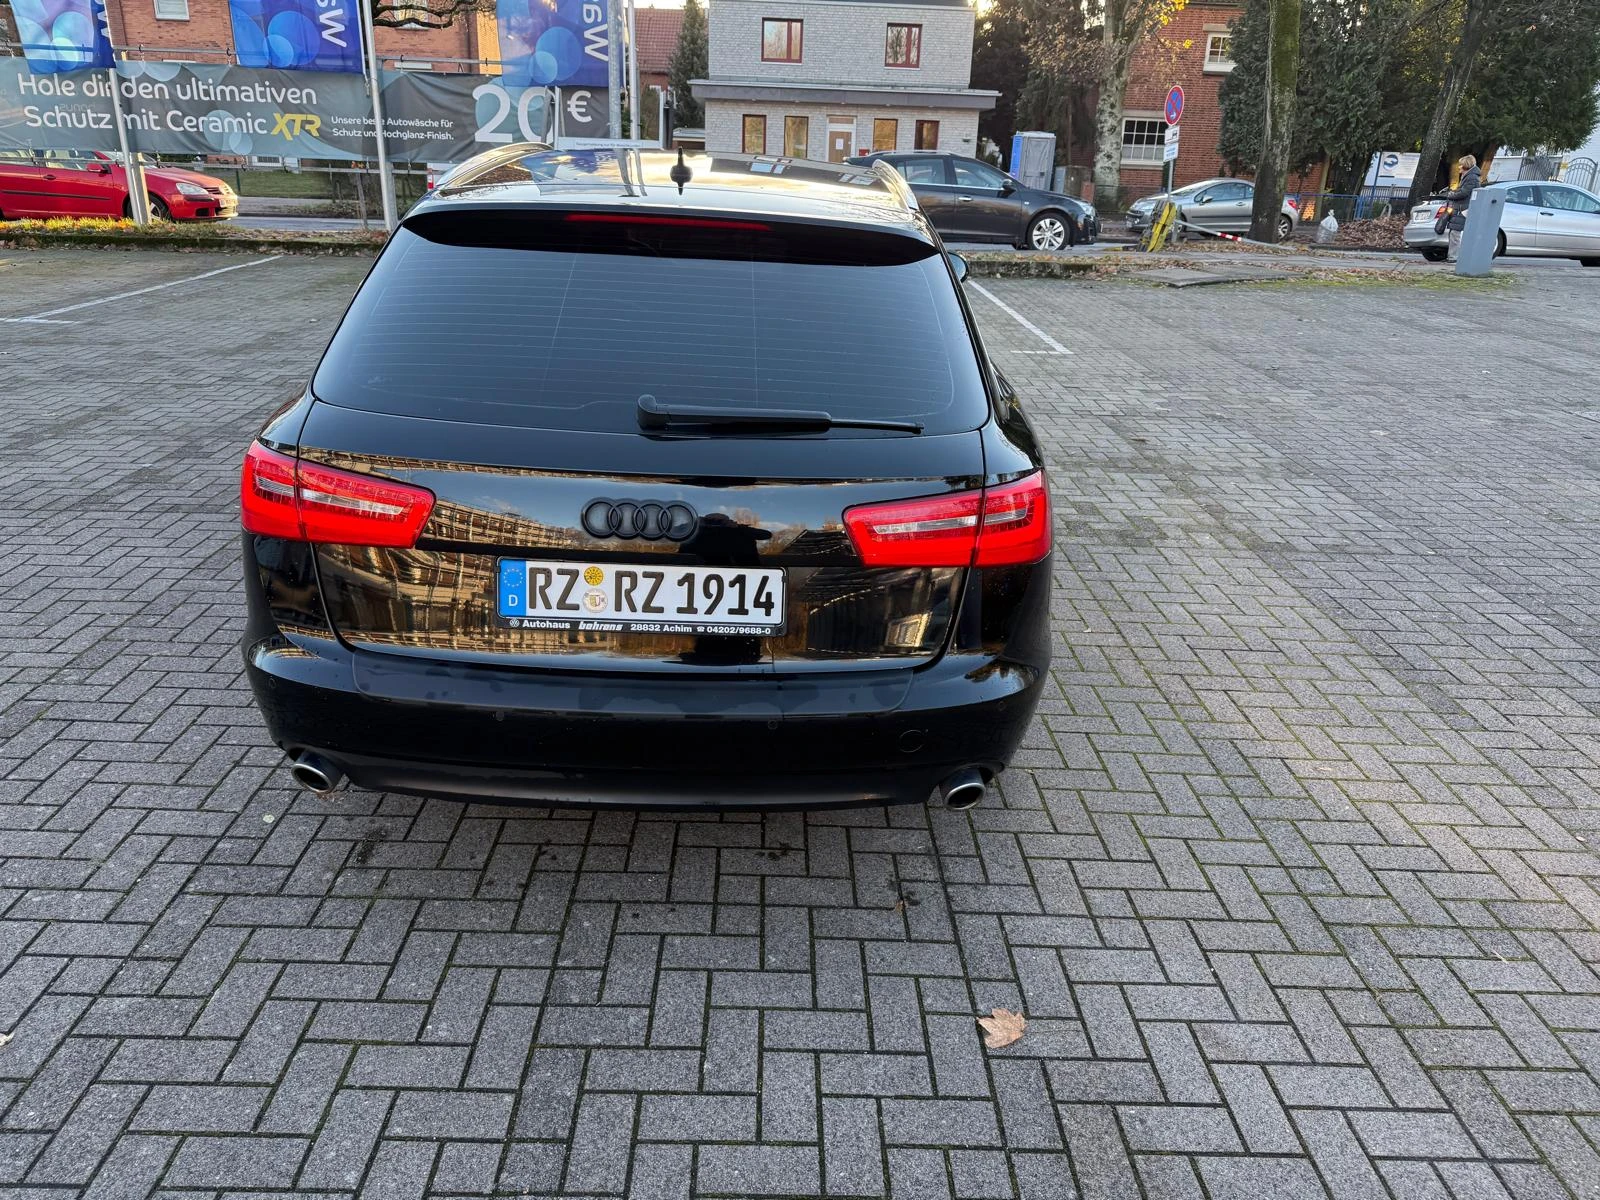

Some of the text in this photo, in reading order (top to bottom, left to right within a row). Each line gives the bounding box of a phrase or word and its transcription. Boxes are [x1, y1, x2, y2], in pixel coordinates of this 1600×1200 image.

[17, 73, 75, 97] Hole
[120, 75, 170, 100] den
[176, 77, 317, 105] ultimativen
[23, 105, 113, 129] Schutz
[166, 110, 268, 135] Ceramic
[270, 113, 322, 140] XTR
[331, 116, 361, 125] Unsere
[387, 117, 439, 127] Autowäsche
[441, 119, 454, 128] für
[472, 84, 593, 144] 20 €
[332, 128, 362, 137] Schutz
[508, 594, 518, 607] D
[528, 566, 775, 617] RZ RZ 1914
[522, 619, 571, 629] Autohaus
[630, 623, 661, 632] 28832
[663, 625, 692, 633] Achim
[706, 625, 771, 635] 04202/9688-0
